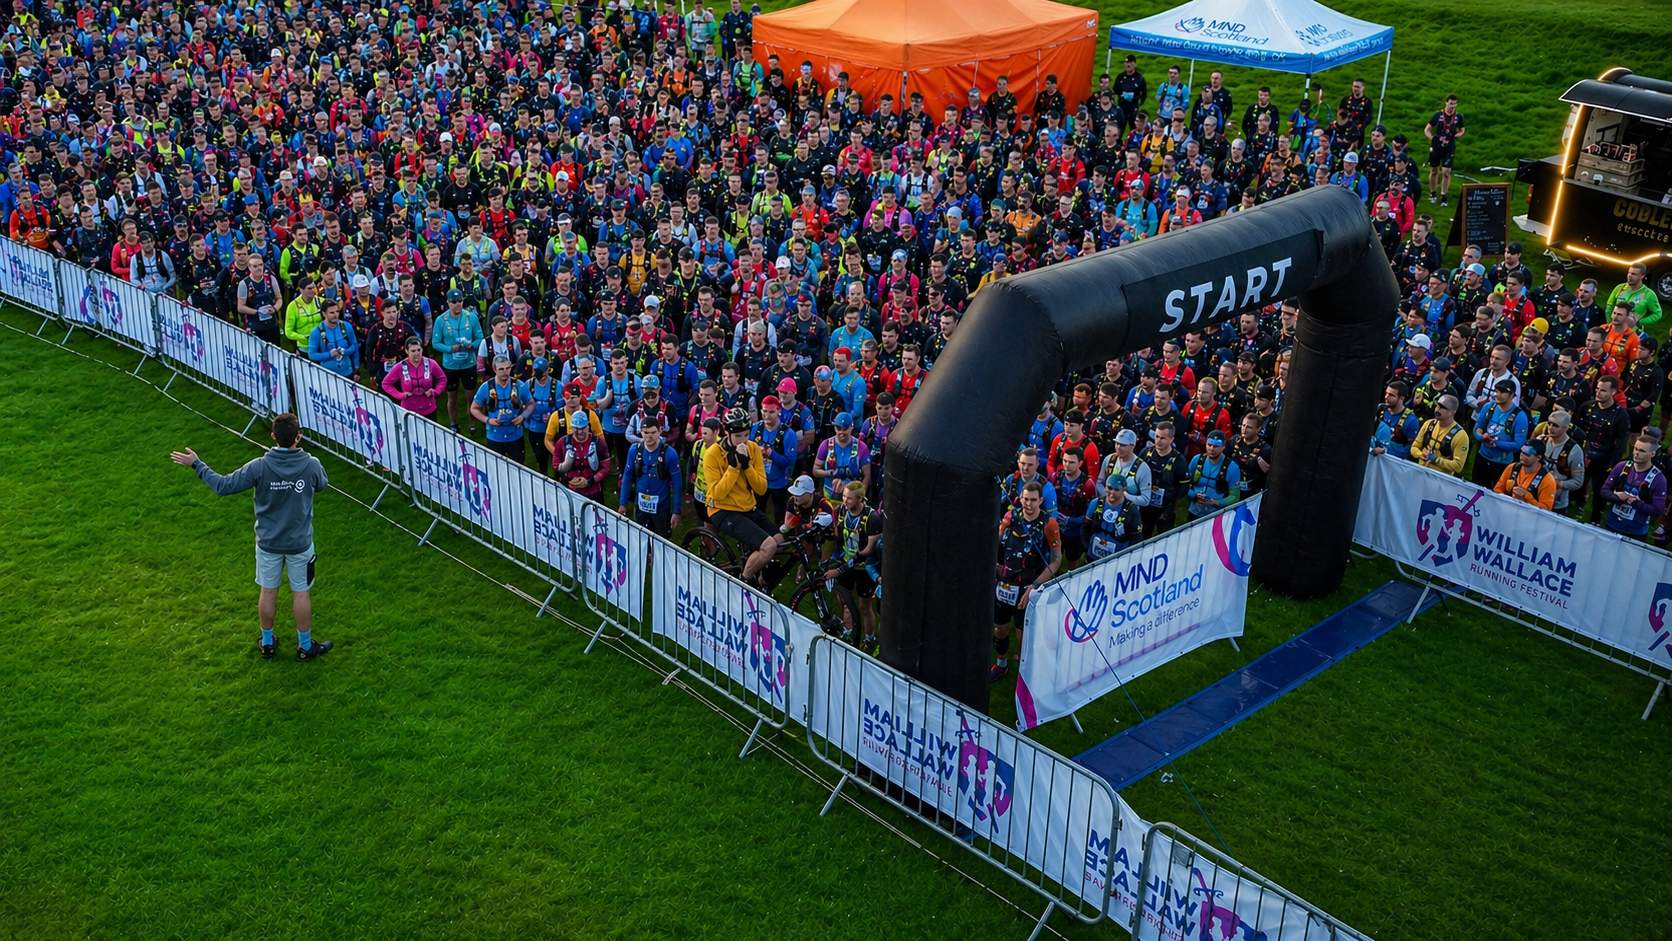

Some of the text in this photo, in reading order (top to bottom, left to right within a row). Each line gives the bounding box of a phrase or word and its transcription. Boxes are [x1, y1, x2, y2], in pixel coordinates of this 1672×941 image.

[1207, 20, 1246, 33] MND
[1158, 256, 1292, 333] START
[1114, 553, 1168, 598] MND
[1474, 544, 1574, 598] WALLACE
[1477, 525, 1577, 578] WILLIAM
[1111, 563, 1203, 628] Scotland
[1470, 563, 1569, 609] RUNNING FESTIVAL
[1109, 624, 1146, 649] Making
[1147, 621, 1153, 632] a
